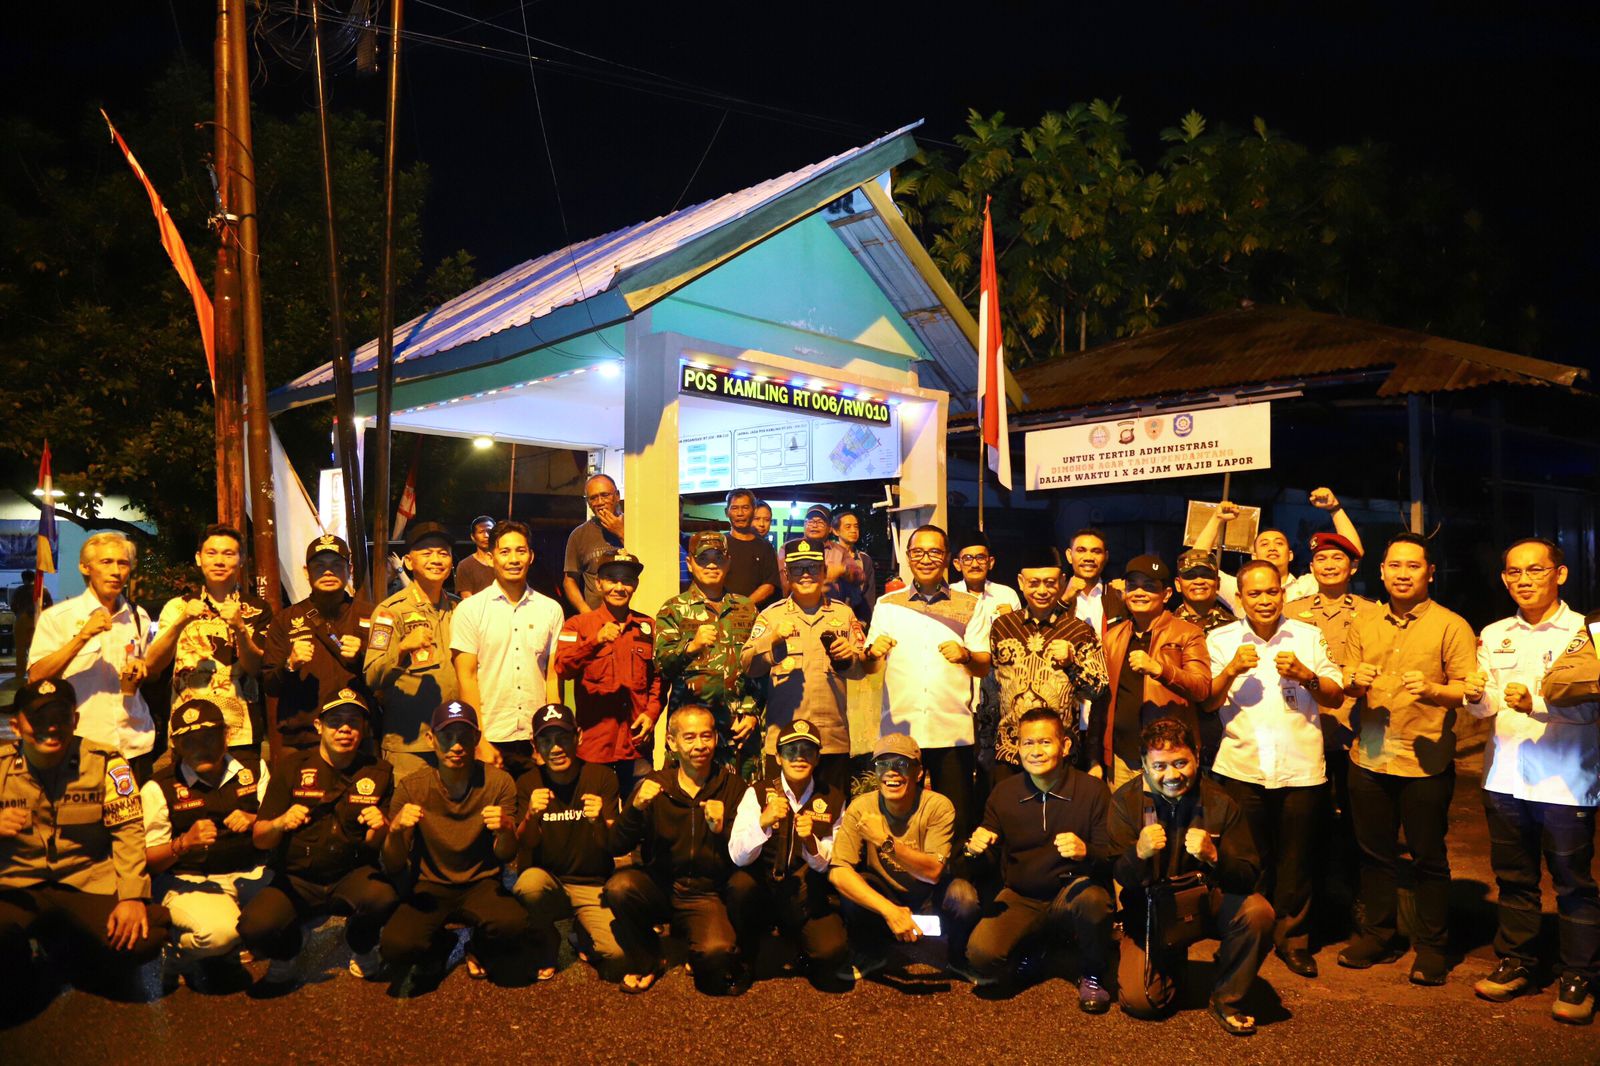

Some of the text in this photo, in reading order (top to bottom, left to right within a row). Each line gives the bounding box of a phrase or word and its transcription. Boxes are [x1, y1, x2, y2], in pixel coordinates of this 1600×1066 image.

[684, 369, 717, 392] POS
[723, 377, 789, 404] KAMLING
[1062, 440, 1220, 464] UNTUK TERTIB ADMINISTRASI
[1039, 456, 1254, 485] DALAM WAKTU 1 X 24 JAM WAJIB LAPOR
[1051, 463, 1095, 474] DIMOHON
[1098, 460, 1124, 470] AGAR
